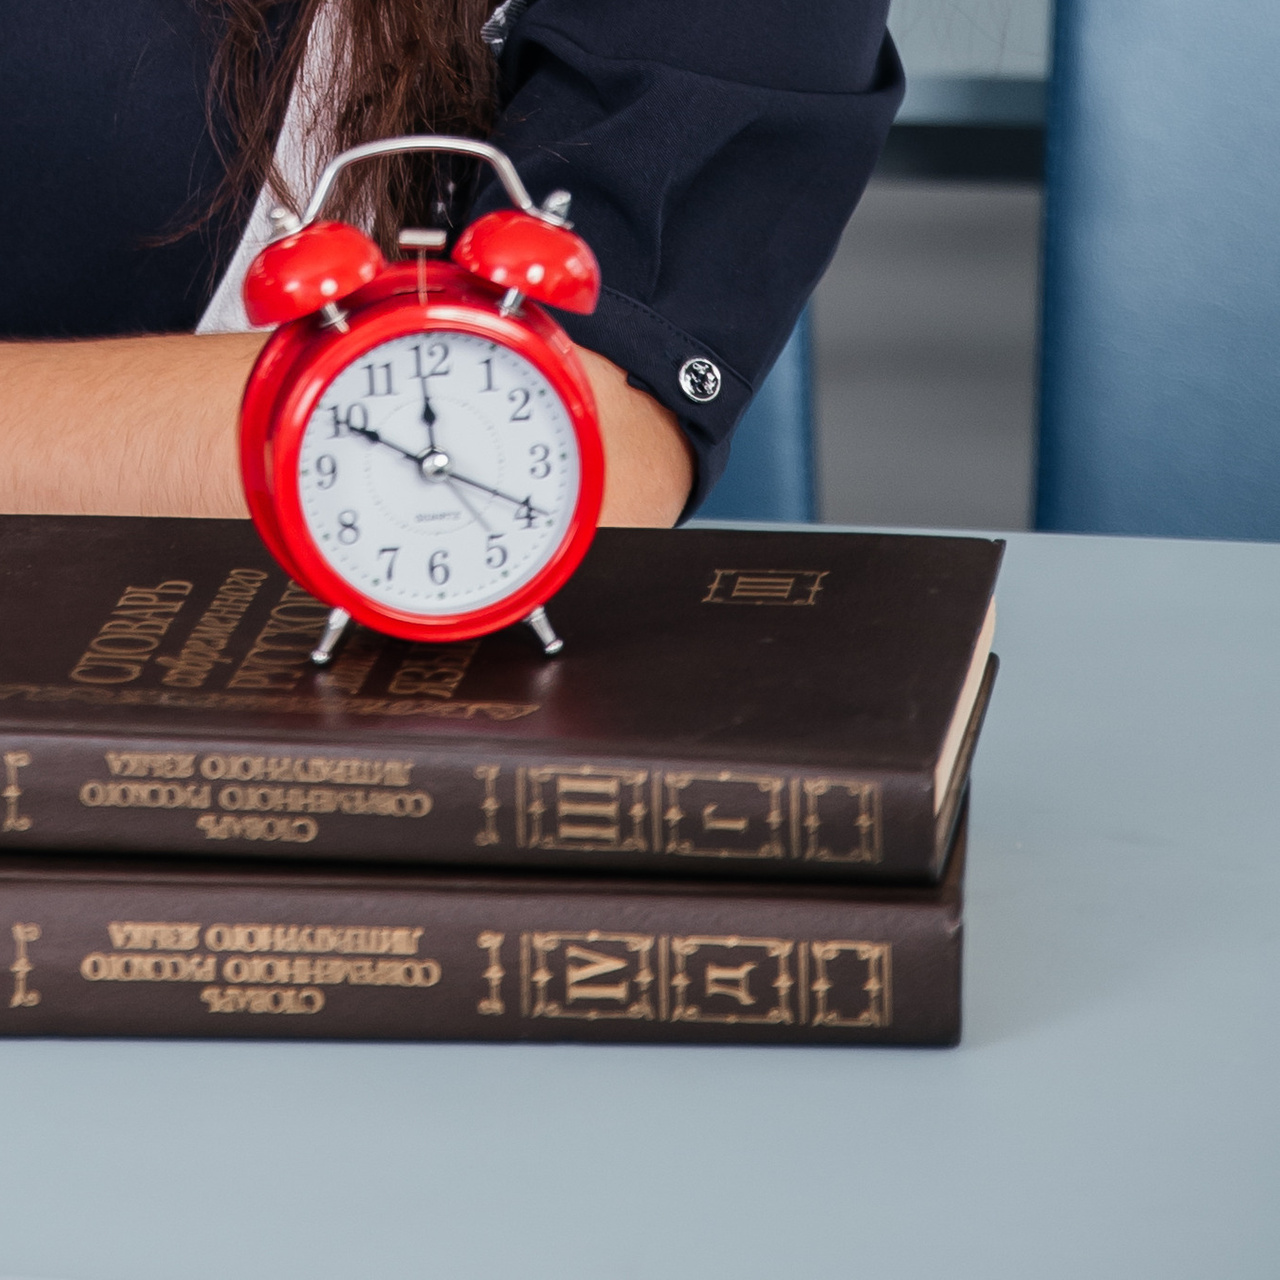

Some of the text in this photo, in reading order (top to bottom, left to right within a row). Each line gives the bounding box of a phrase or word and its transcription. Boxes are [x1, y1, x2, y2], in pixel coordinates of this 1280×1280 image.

[363, 361, 399, 397] 11
[409, 342, 450, 380] 12
[477, 357, 501, 392] 1
[326, 402, 368, 440] 10
[507, 388, 532, 423] 2
[316, 453, 337, 490] 9
[529, 443, 551, 479] 3
[337, 509, 360, 546] 8
[514, 495, 539, 529] 4
[376, 547, 400, 582] 7
[428, 549, 450, 585] 6
[486, 533, 508, 569] 5
[69, 579, 194, 685] СЛОВАРЬ
[556, 774, 619, 840] III
[565, 943, 628, 1004] IV
[705, 960, 759, 1006] Д
